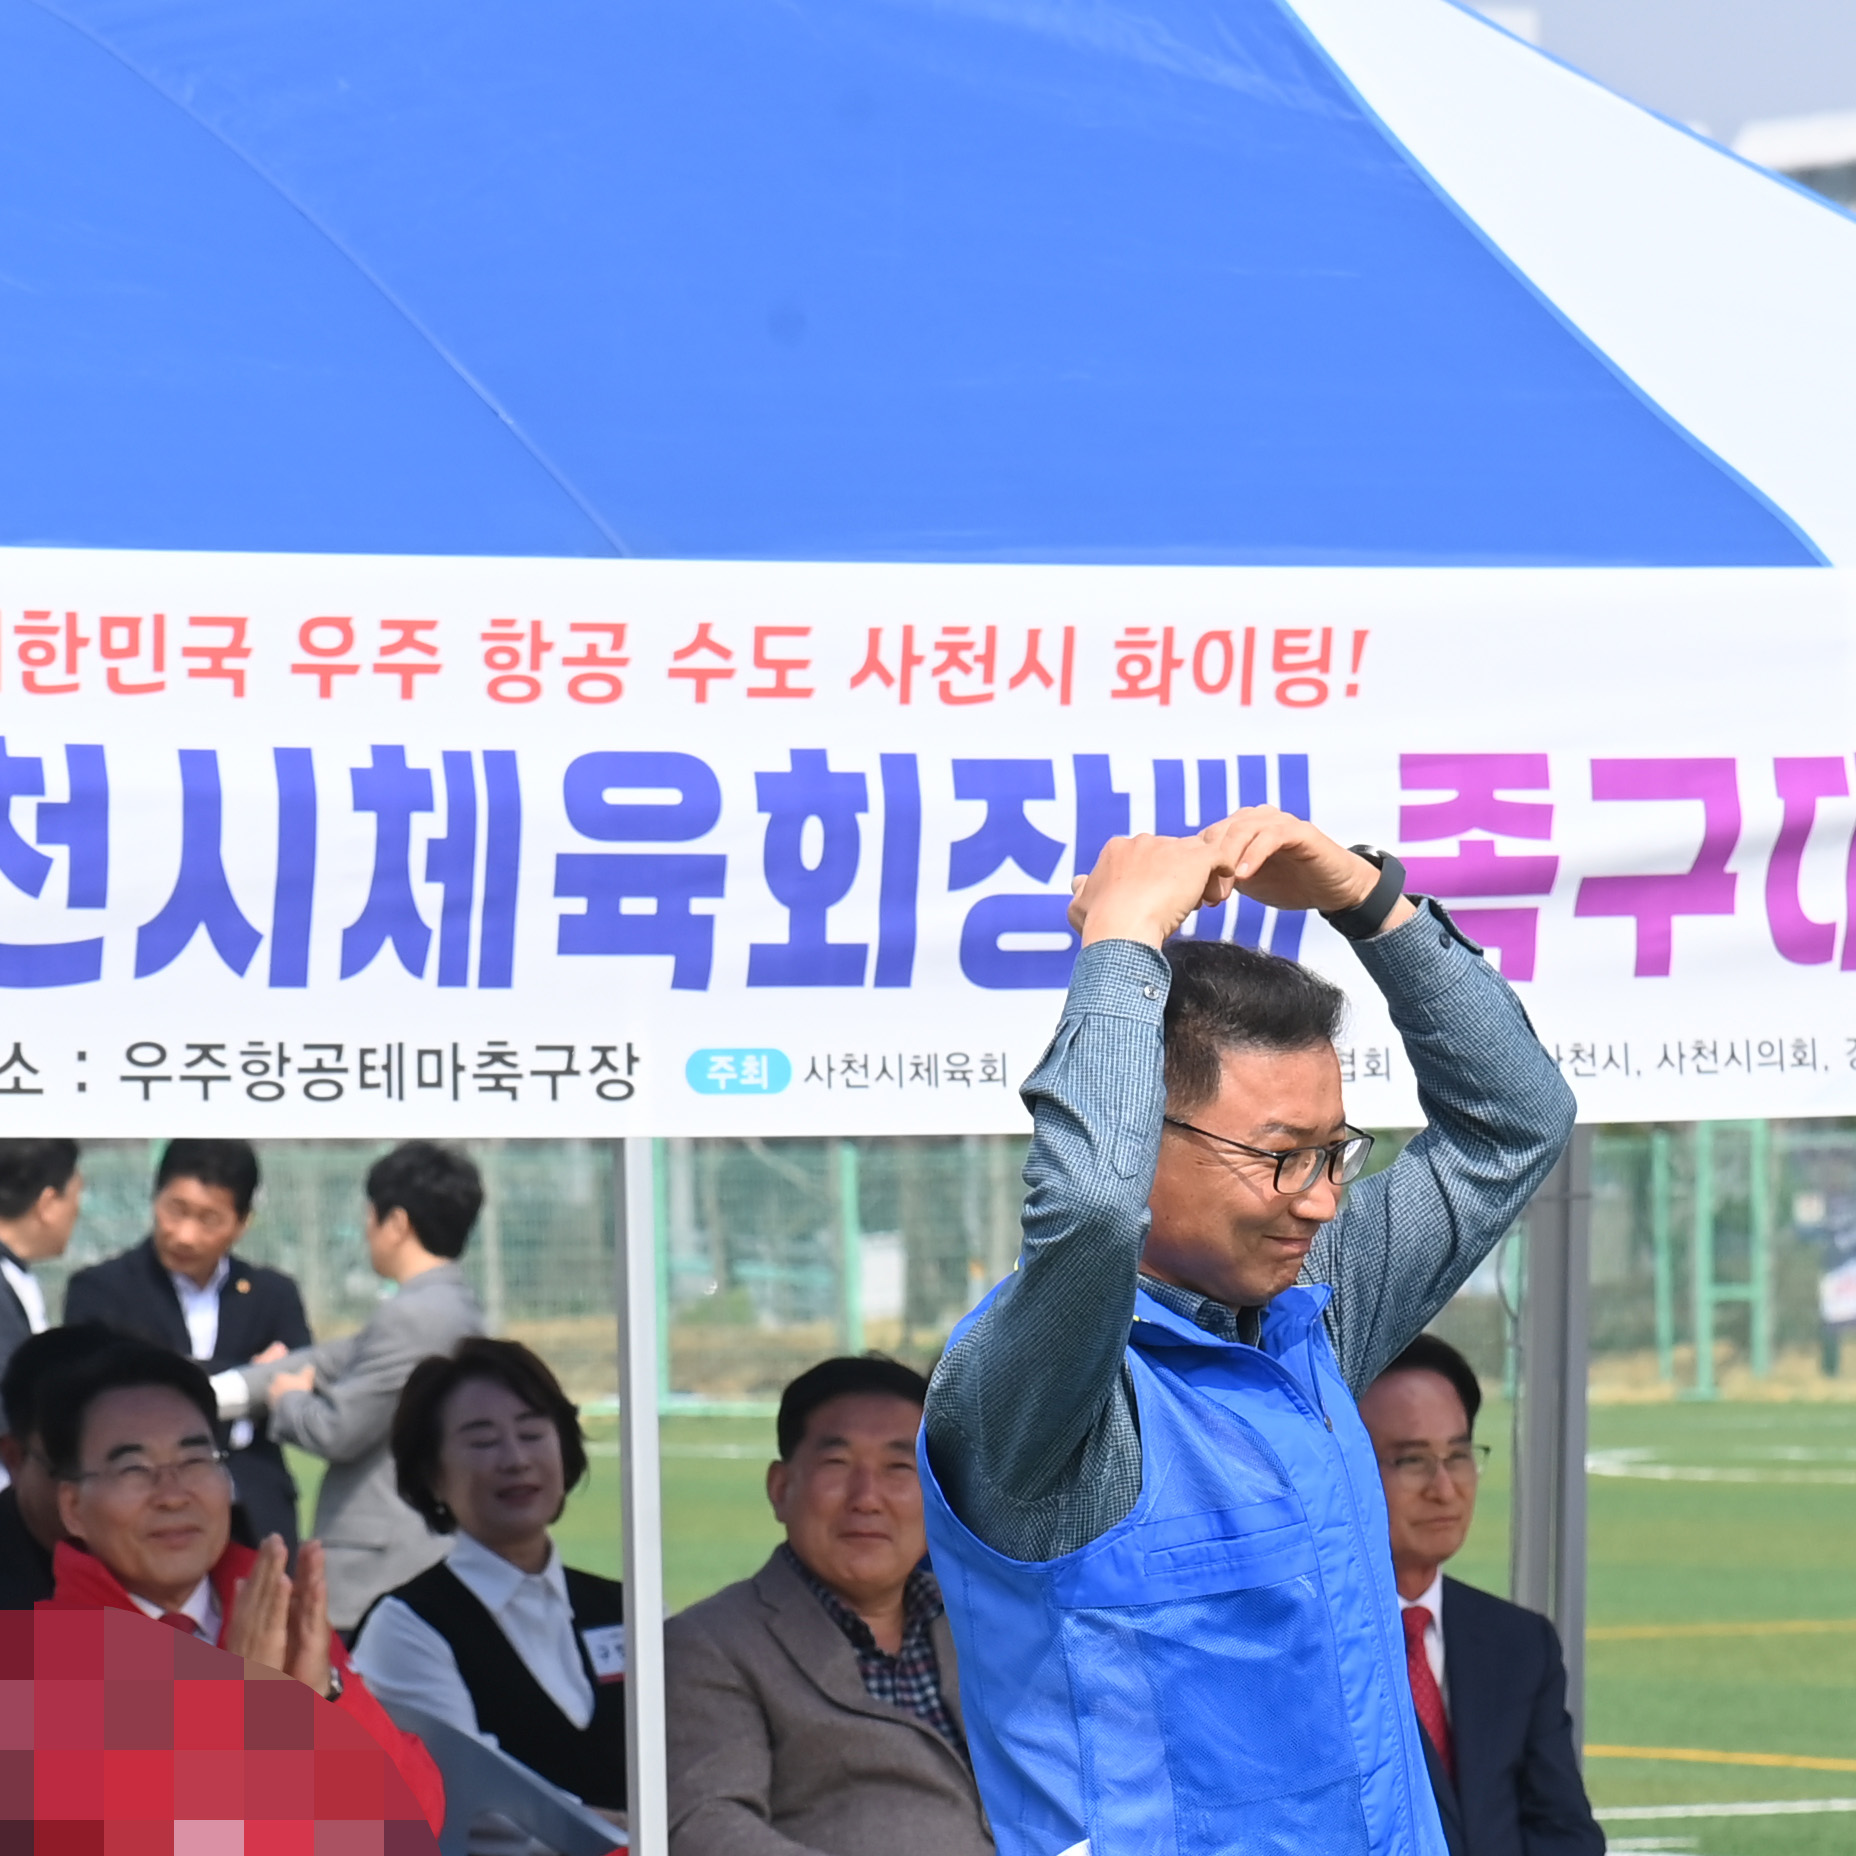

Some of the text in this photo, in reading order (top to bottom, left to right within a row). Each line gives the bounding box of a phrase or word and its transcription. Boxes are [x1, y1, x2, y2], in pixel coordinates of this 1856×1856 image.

[290, 615, 443, 701] 우주
[480, 618, 631, 705] 항공
[667, 622, 815, 704] 수도
[849, 624, 1076, 707] 사천시
[1110, 625, 1371, 709] 화이팅!
[118, 1040, 641, 1102] 우주항공테마축구장
[706, 1054, 770, 1091] 주최
[804, 1052, 1007, 1089] 사천시체육회
[1657, 1038, 1829, 1075] 사천시의회,
